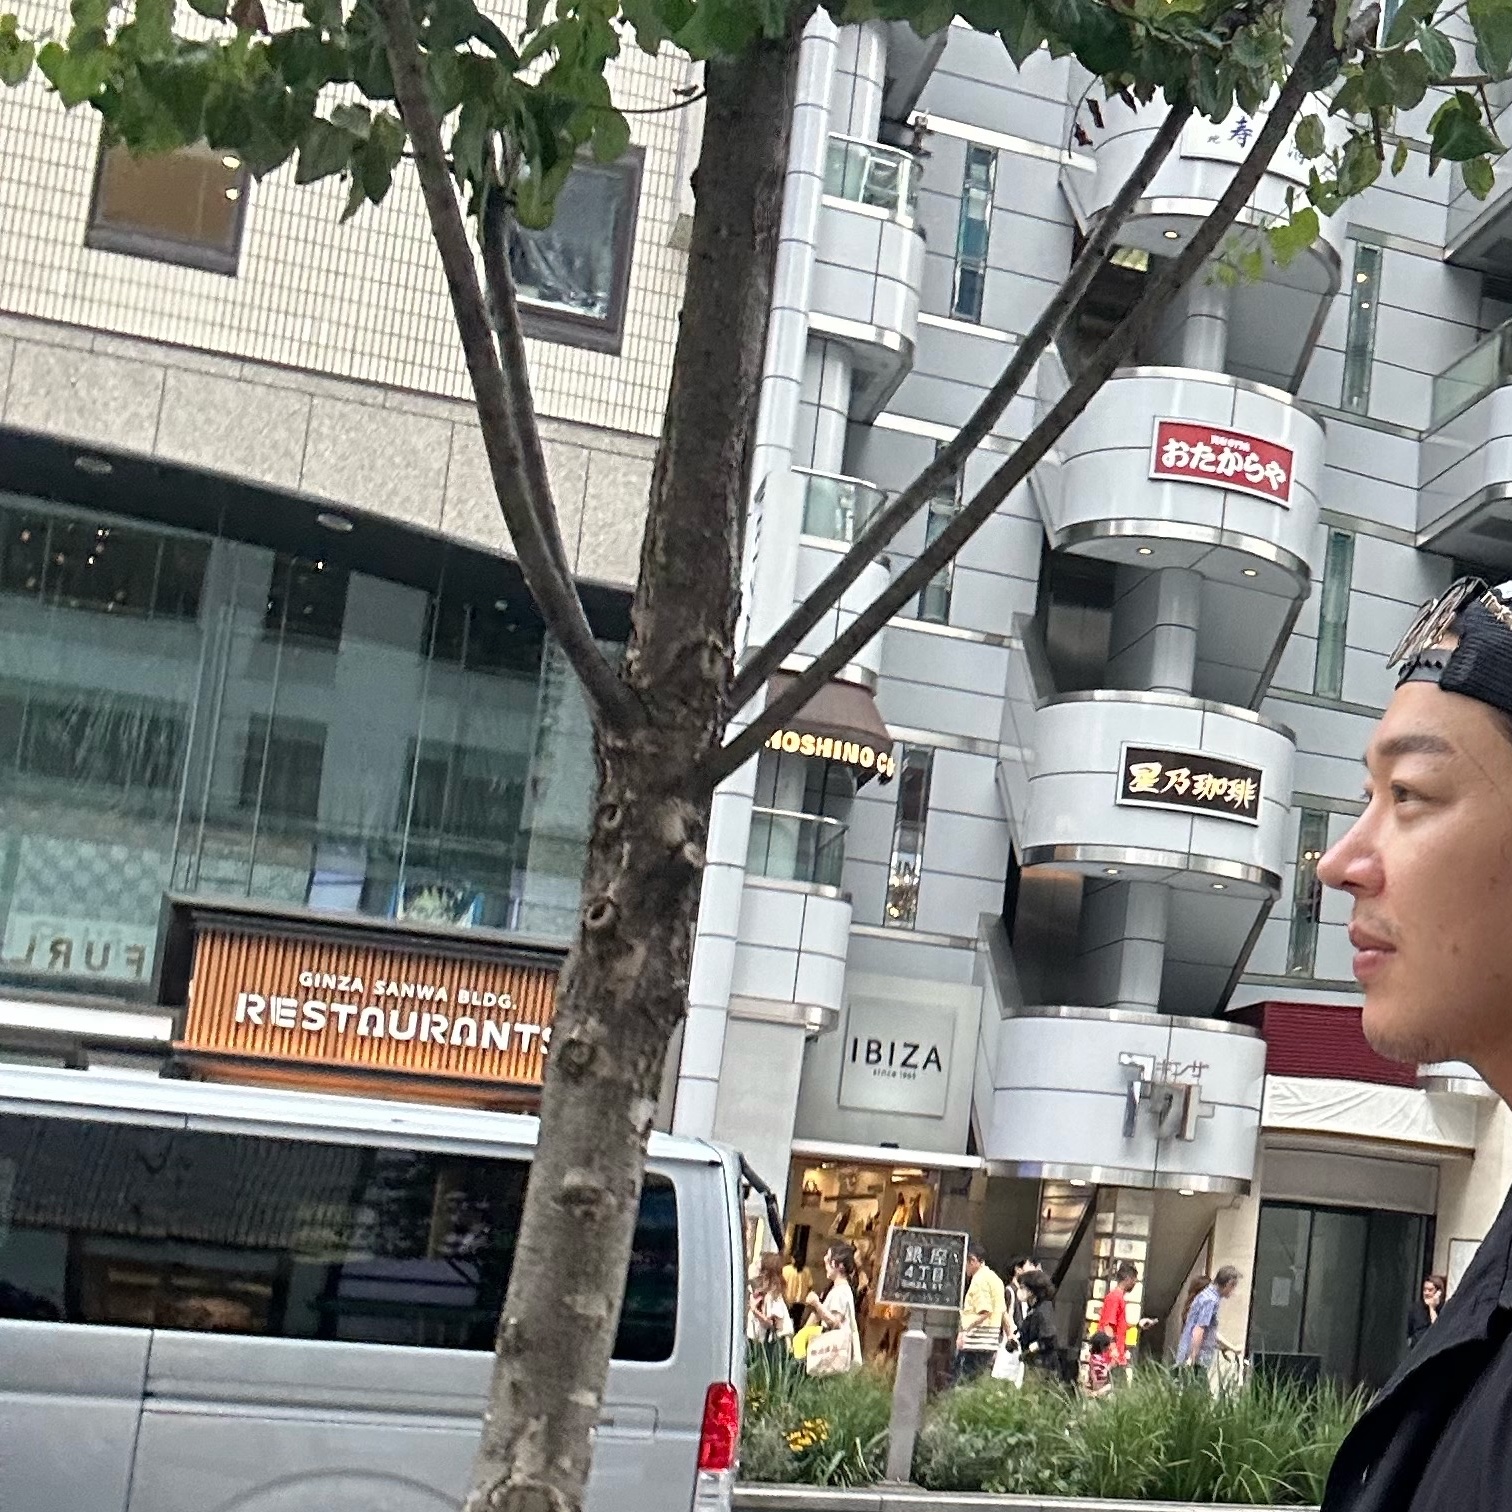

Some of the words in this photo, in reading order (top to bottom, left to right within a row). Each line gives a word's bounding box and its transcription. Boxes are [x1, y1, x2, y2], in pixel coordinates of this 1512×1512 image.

[1161, 437, 1287, 491] おたからや
[1128, 761, 1258, 809] 星乃珈琲
[299, 971, 363, 993] GINZA
[374, 979, 449, 1003] SANWA
[458, 989, 518, 1011] BLDG.
[235, 992, 552, 1055] RESTAURANT
[851, 1037, 942, 1073] IBIZA
